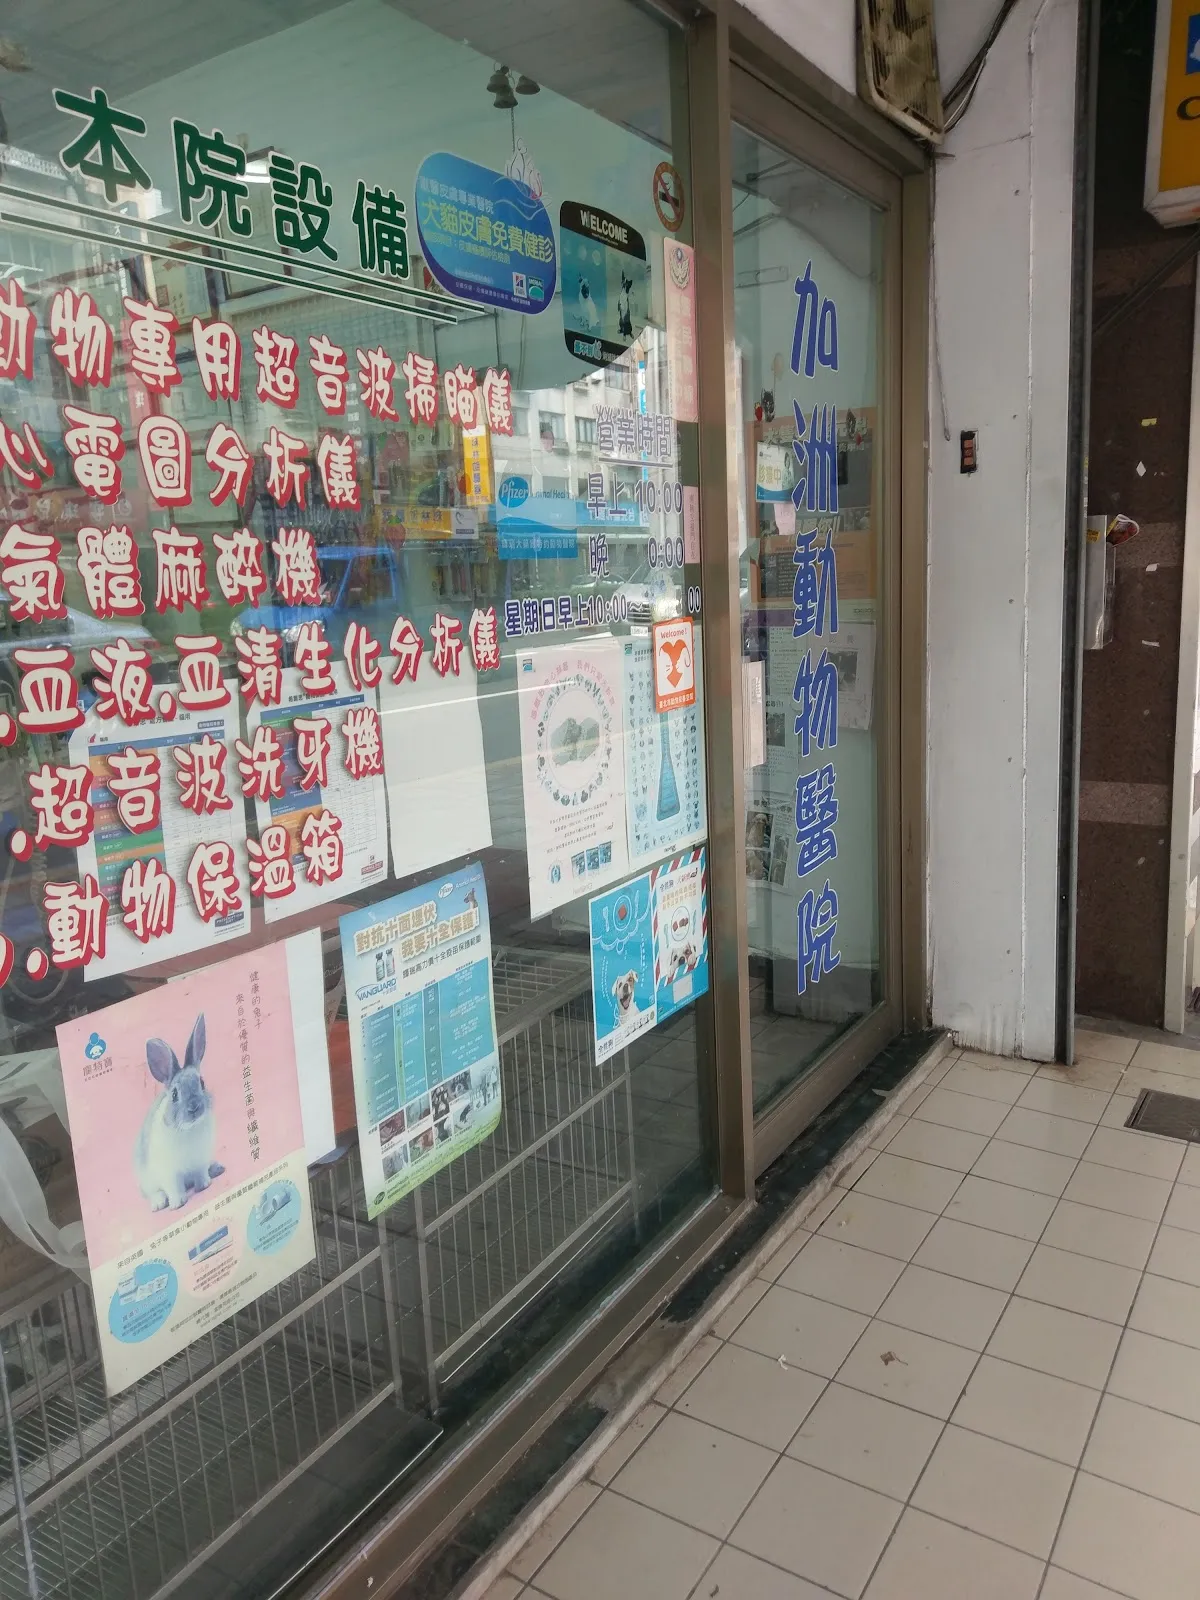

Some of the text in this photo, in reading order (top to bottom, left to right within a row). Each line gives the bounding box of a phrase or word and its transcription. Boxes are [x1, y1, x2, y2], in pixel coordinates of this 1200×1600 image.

[52, 86, 410, 280] 本院設備
[422, 198, 554, 263] 犬貓皮膚免費健診
[580, 210, 629, 244] WELCOME
[594, 403, 673, 457] 營業時間
[0, 404, 361, 511] 心電圖分析儀
[501, 481, 528, 507] Pfizer
[0, 524, 323, 623] 氣體麻醉機
[589, 533, 609, 578] 晚
[660, 628, 688, 640] Welcome!
[790, 259, 841, 996] 加洲動物醫院
[355, 903, 437, 954] 對抗十面埋伏
[249, 970, 263, 1030] 健康的兔子
[357, 978, 397, 1001] VANGUARD
